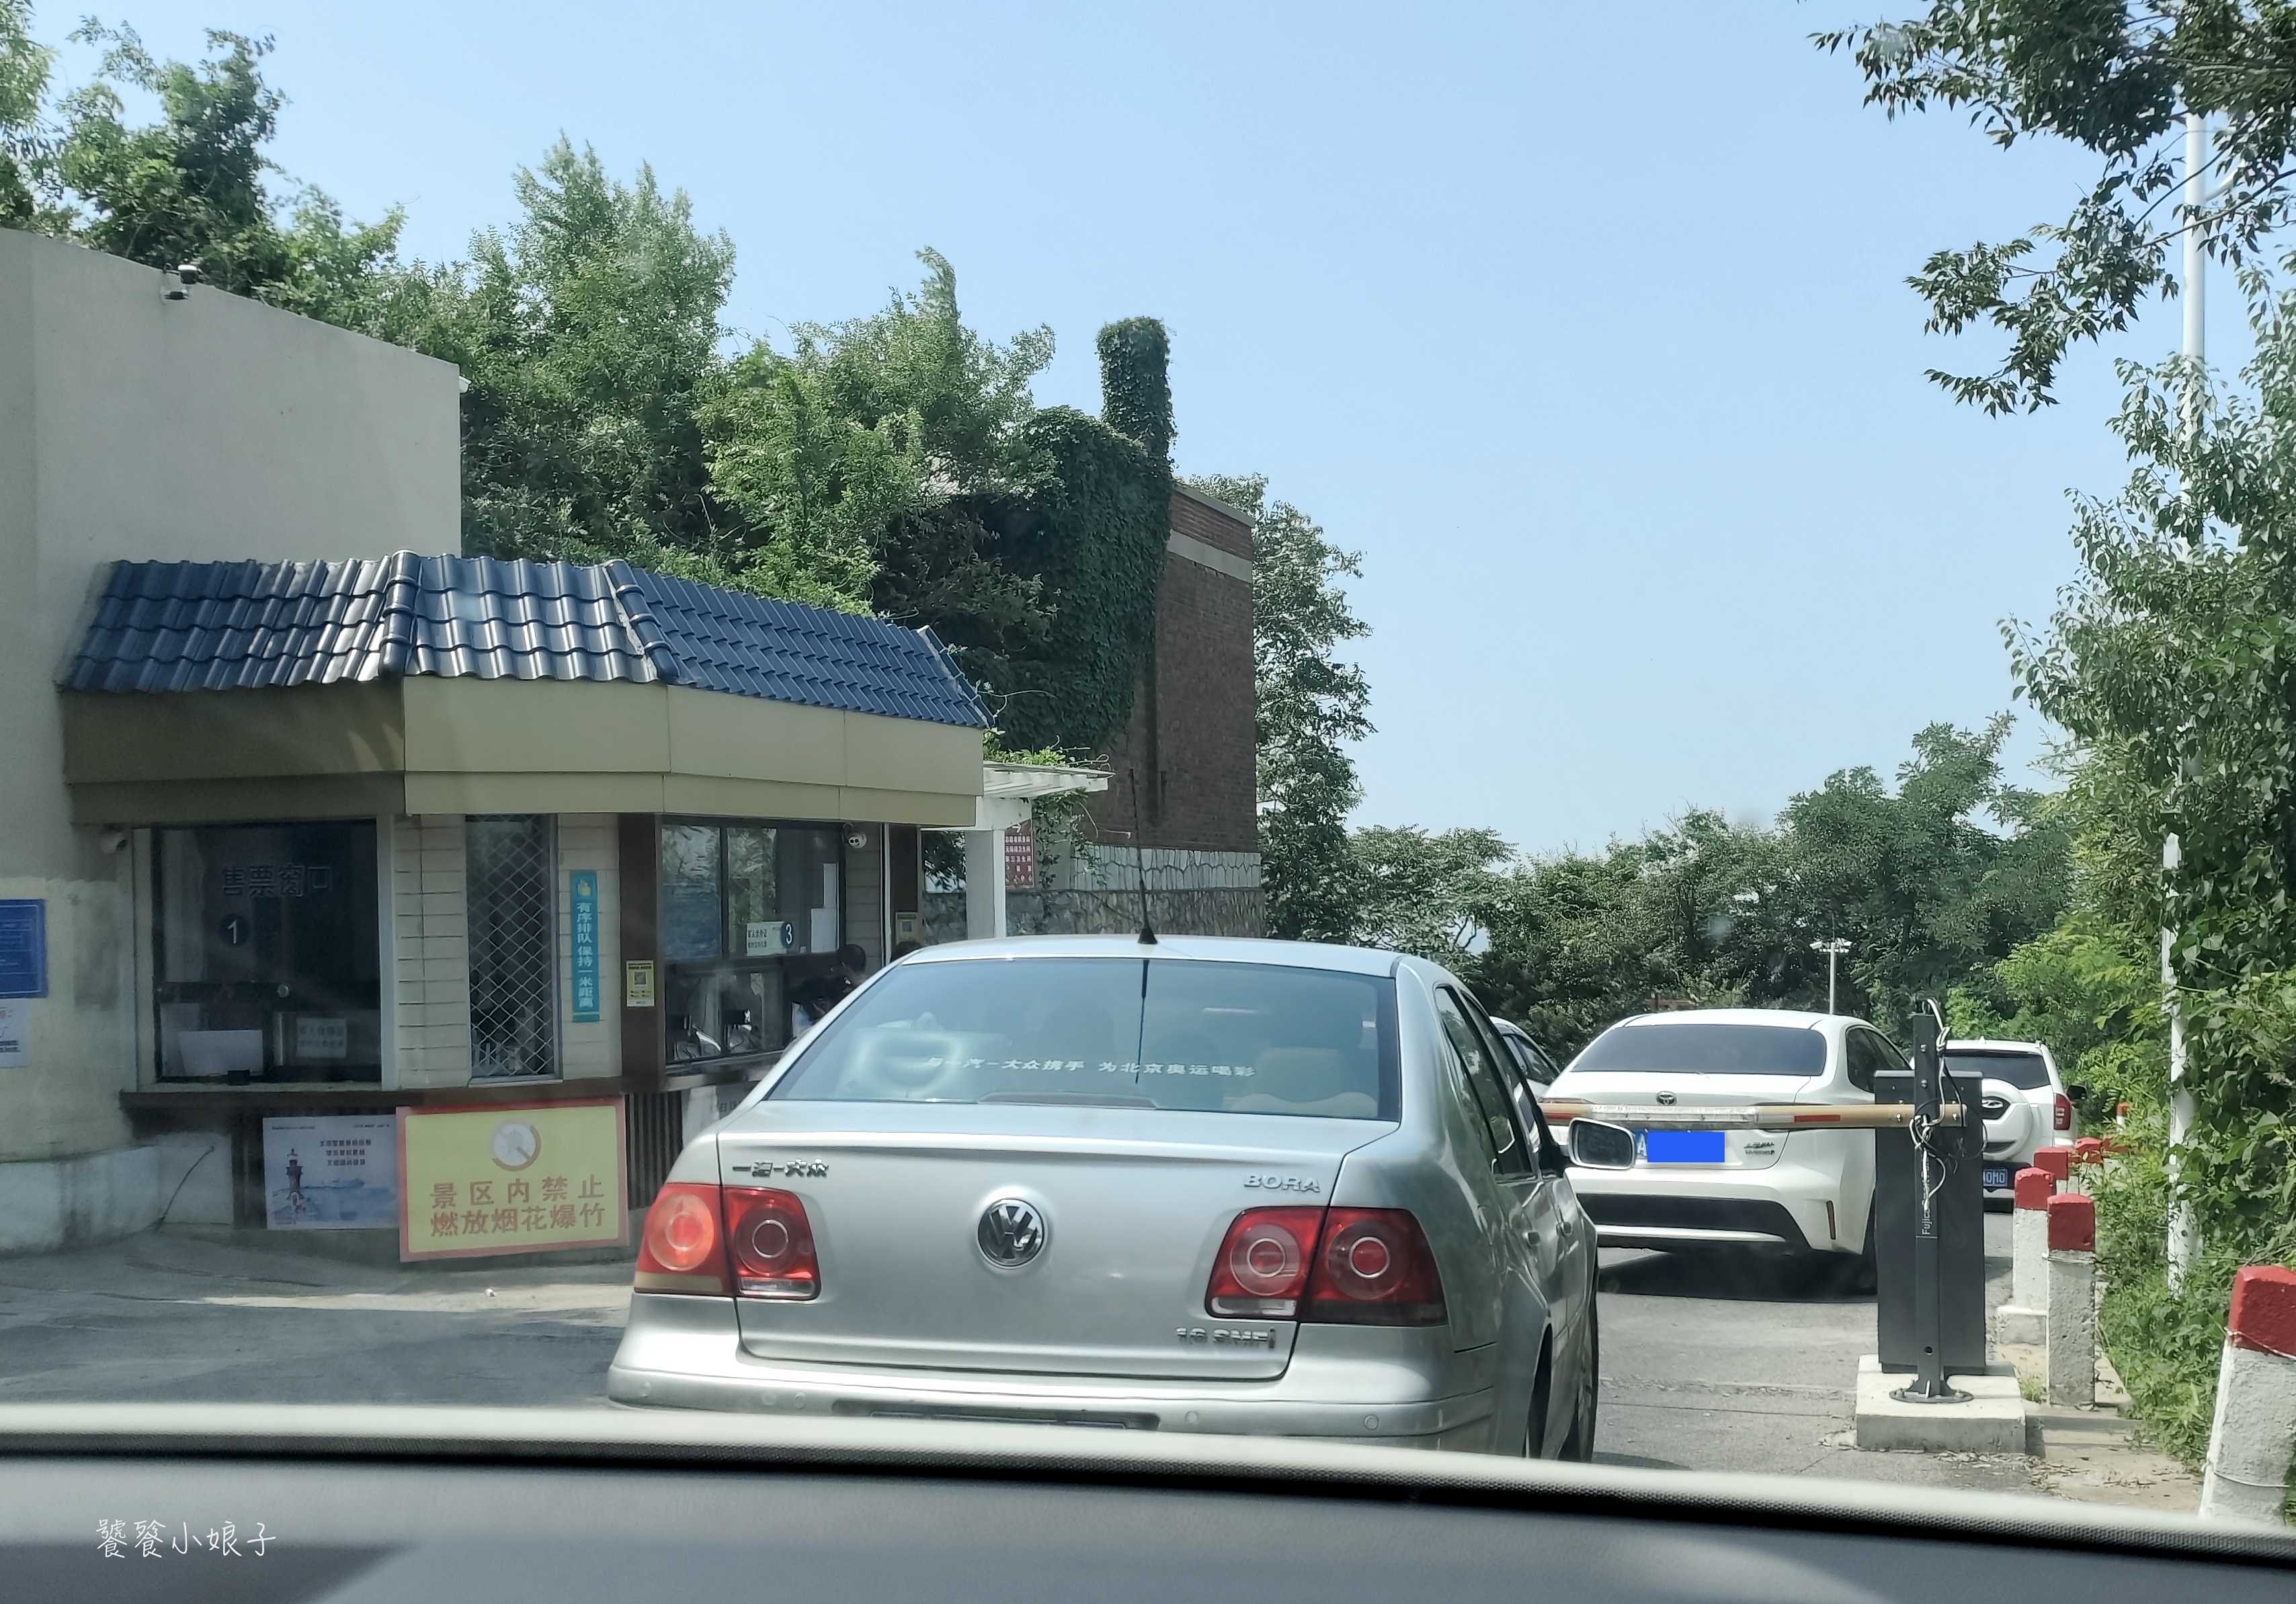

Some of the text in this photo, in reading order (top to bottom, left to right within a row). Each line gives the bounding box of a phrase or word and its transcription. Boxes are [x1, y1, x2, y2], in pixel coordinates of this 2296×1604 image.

[226, 919, 237, 945] 1
[786, 923, 792, 945] 3
[577, 902, 593, 1008] 有序排队 保持一米距离
[1098, 1061, 1256, 1077] 为北京奥运喝彩
[430, 1174, 604, 1209] 景区内禁止
[1243, 1173, 1321, 1193] BORA
[430, 1203, 605, 1237] 燃放烟花爆竹
